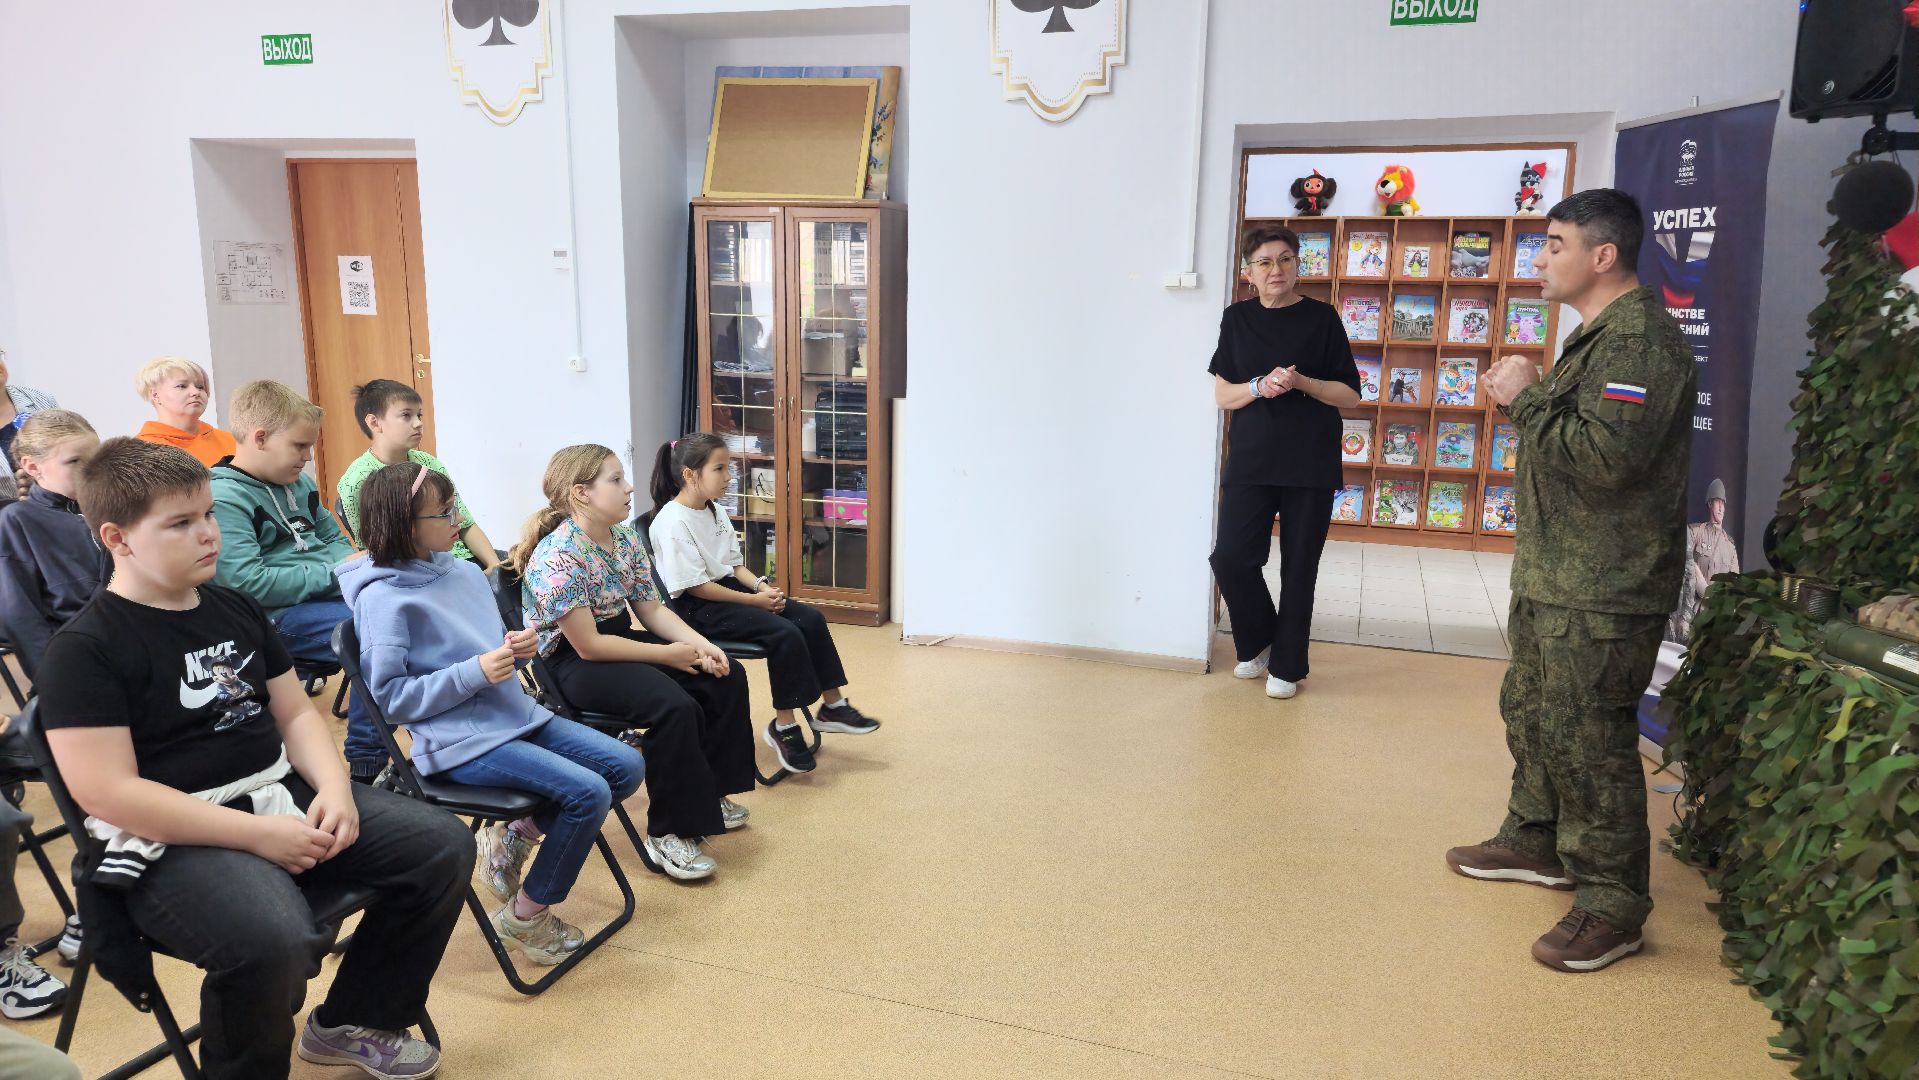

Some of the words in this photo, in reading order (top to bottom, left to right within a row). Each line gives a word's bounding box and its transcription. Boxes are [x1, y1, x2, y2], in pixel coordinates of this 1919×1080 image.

[1393, 0, 1475, 19] ВЫХОД
[263, 37, 312, 61] ВЫХОД
[1653, 206, 1718, 230] УСПЕХ
